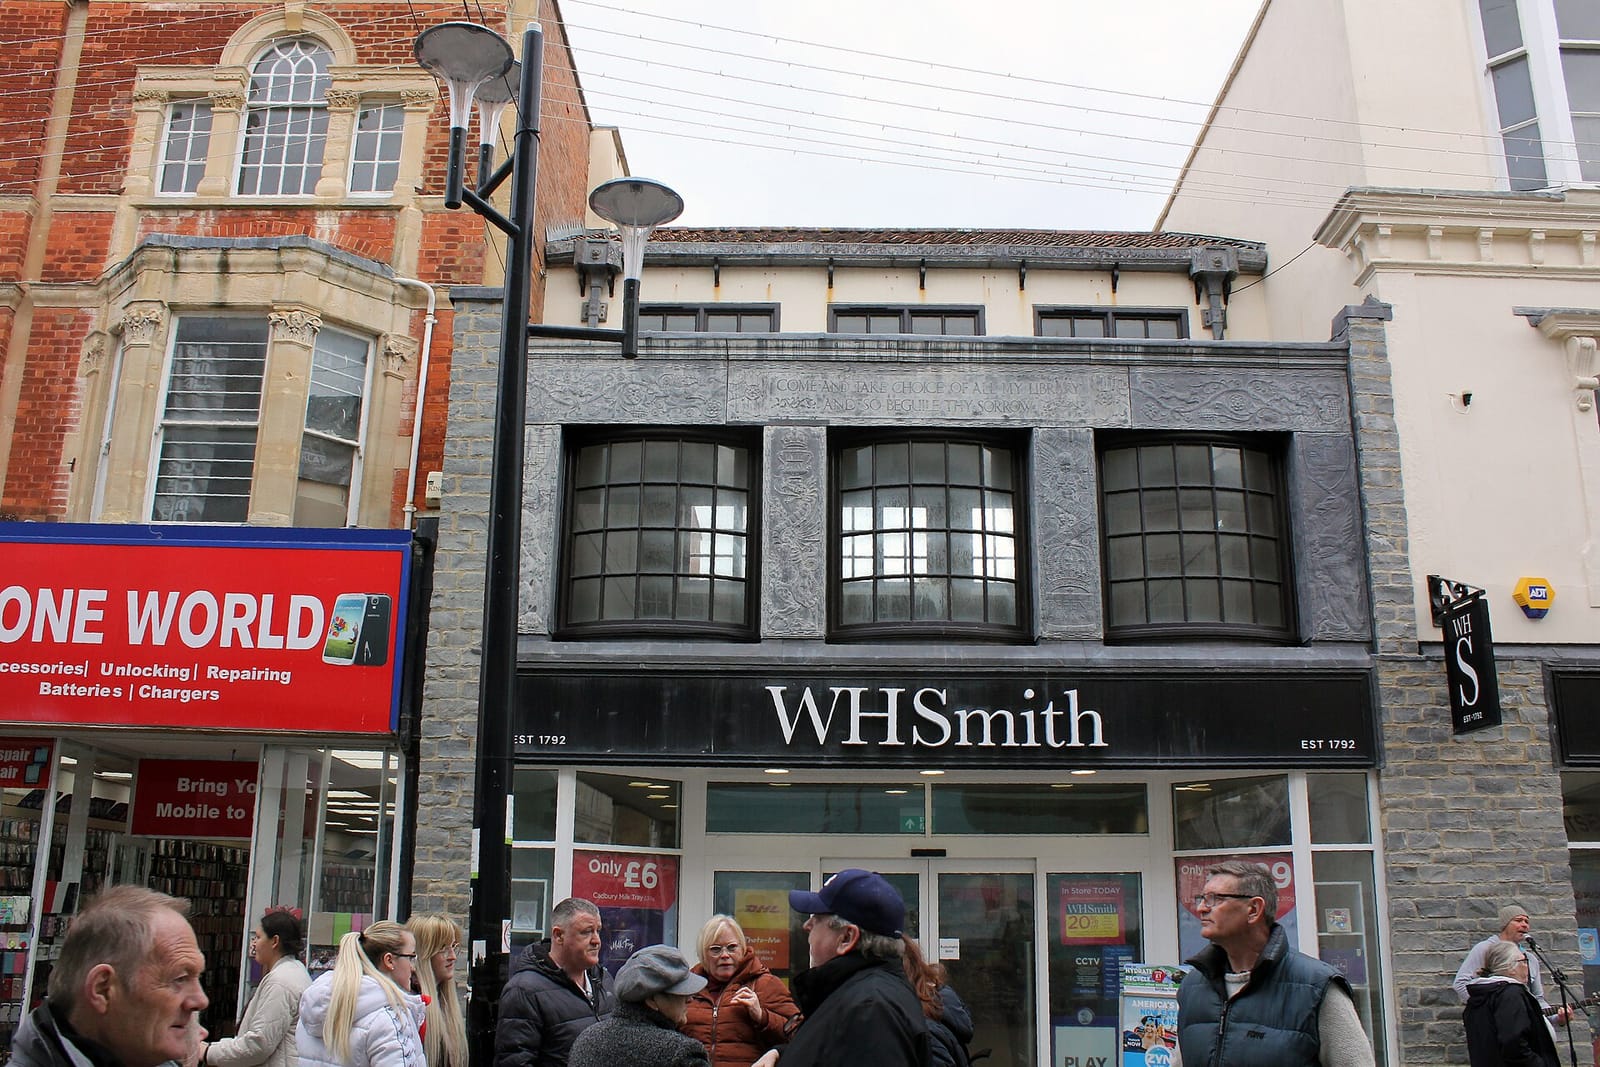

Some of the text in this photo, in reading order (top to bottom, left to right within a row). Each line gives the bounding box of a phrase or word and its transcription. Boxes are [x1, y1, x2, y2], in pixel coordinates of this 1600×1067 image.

[776, 379, 817, 392] COME
[821, 380, 850, 392] AND
[855, 381, 887, 393] TAKE
[892, 381, 944, 394] CHOICE
[951, 382, 969, 394] OF
[973, 382, 995, 394] ALL
[1002, 382, 1022, 394] MY
[823, 399, 1033, 413] AND SO BEGUILE THY SORROW
[1529, 587, 1547, 598] ADT
[0, 585, 325, 650] ONE WORLD
[1452, 613, 1473, 638] WH
[206, 665, 292, 685] Repairing
[1456, 635, 1479, 707] S
[39, 681, 123, 698] Batteries
[138, 684, 220, 703] Chargers
[765, 686, 1109, 748] WHSmith
[514, 734, 566, 745] EST 1792
[1301, 739, 1356, 749] EST 1792
[177, 777, 229, 797] Bring
[156, 802, 246, 820] Mobile to
[588, 859, 658, 889] Only £6
[1181, 864, 1204, 876] Only
[592, 891, 618, 901] Cadbury
[1071, 887, 1092, 895] Store
[1093, 887, 1121, 895] TODAY
[1067, 903, 1117, 914] WHSmith
[1075, 957, 1100, 966] CCTV
